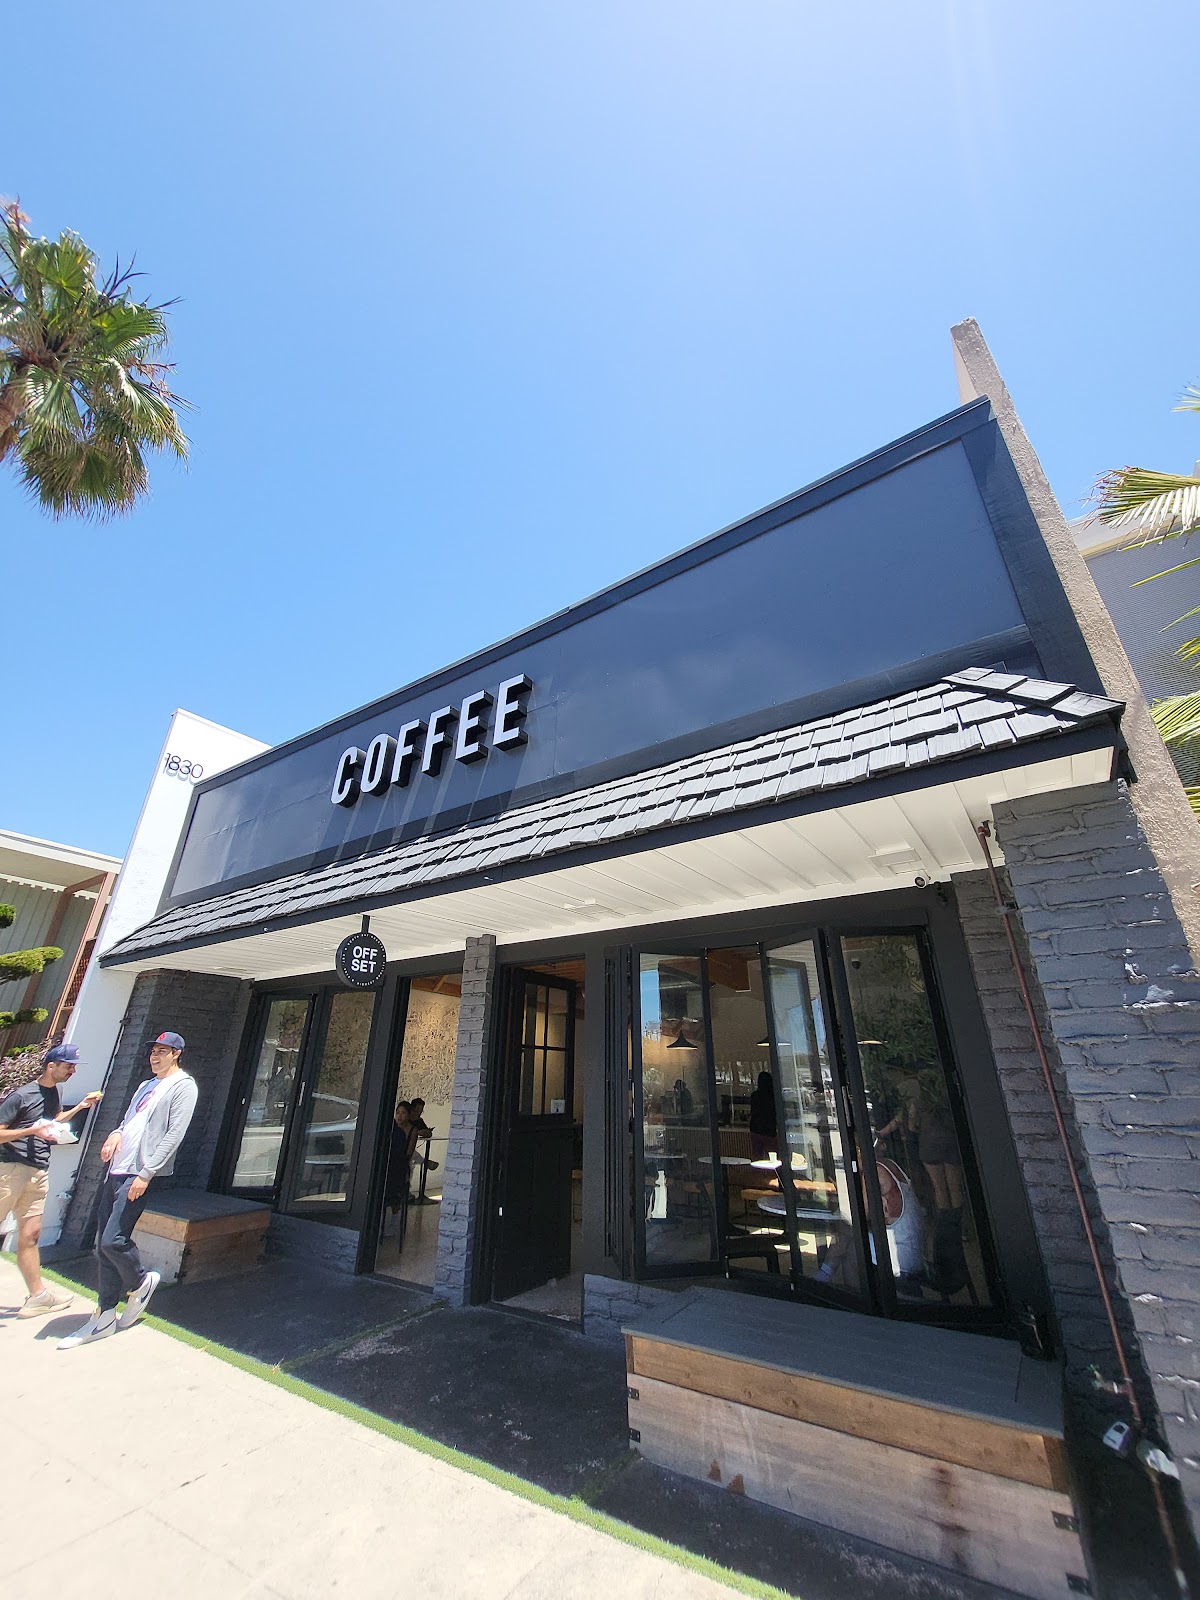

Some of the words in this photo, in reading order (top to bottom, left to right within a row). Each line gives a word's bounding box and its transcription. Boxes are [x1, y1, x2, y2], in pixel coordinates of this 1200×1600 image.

[331, 673, 531, 807] COFFEE
[163, 752, 203, 778] 1830
[352, 945, 378, 960] OFF
[351, 959, 376, 973] SET
